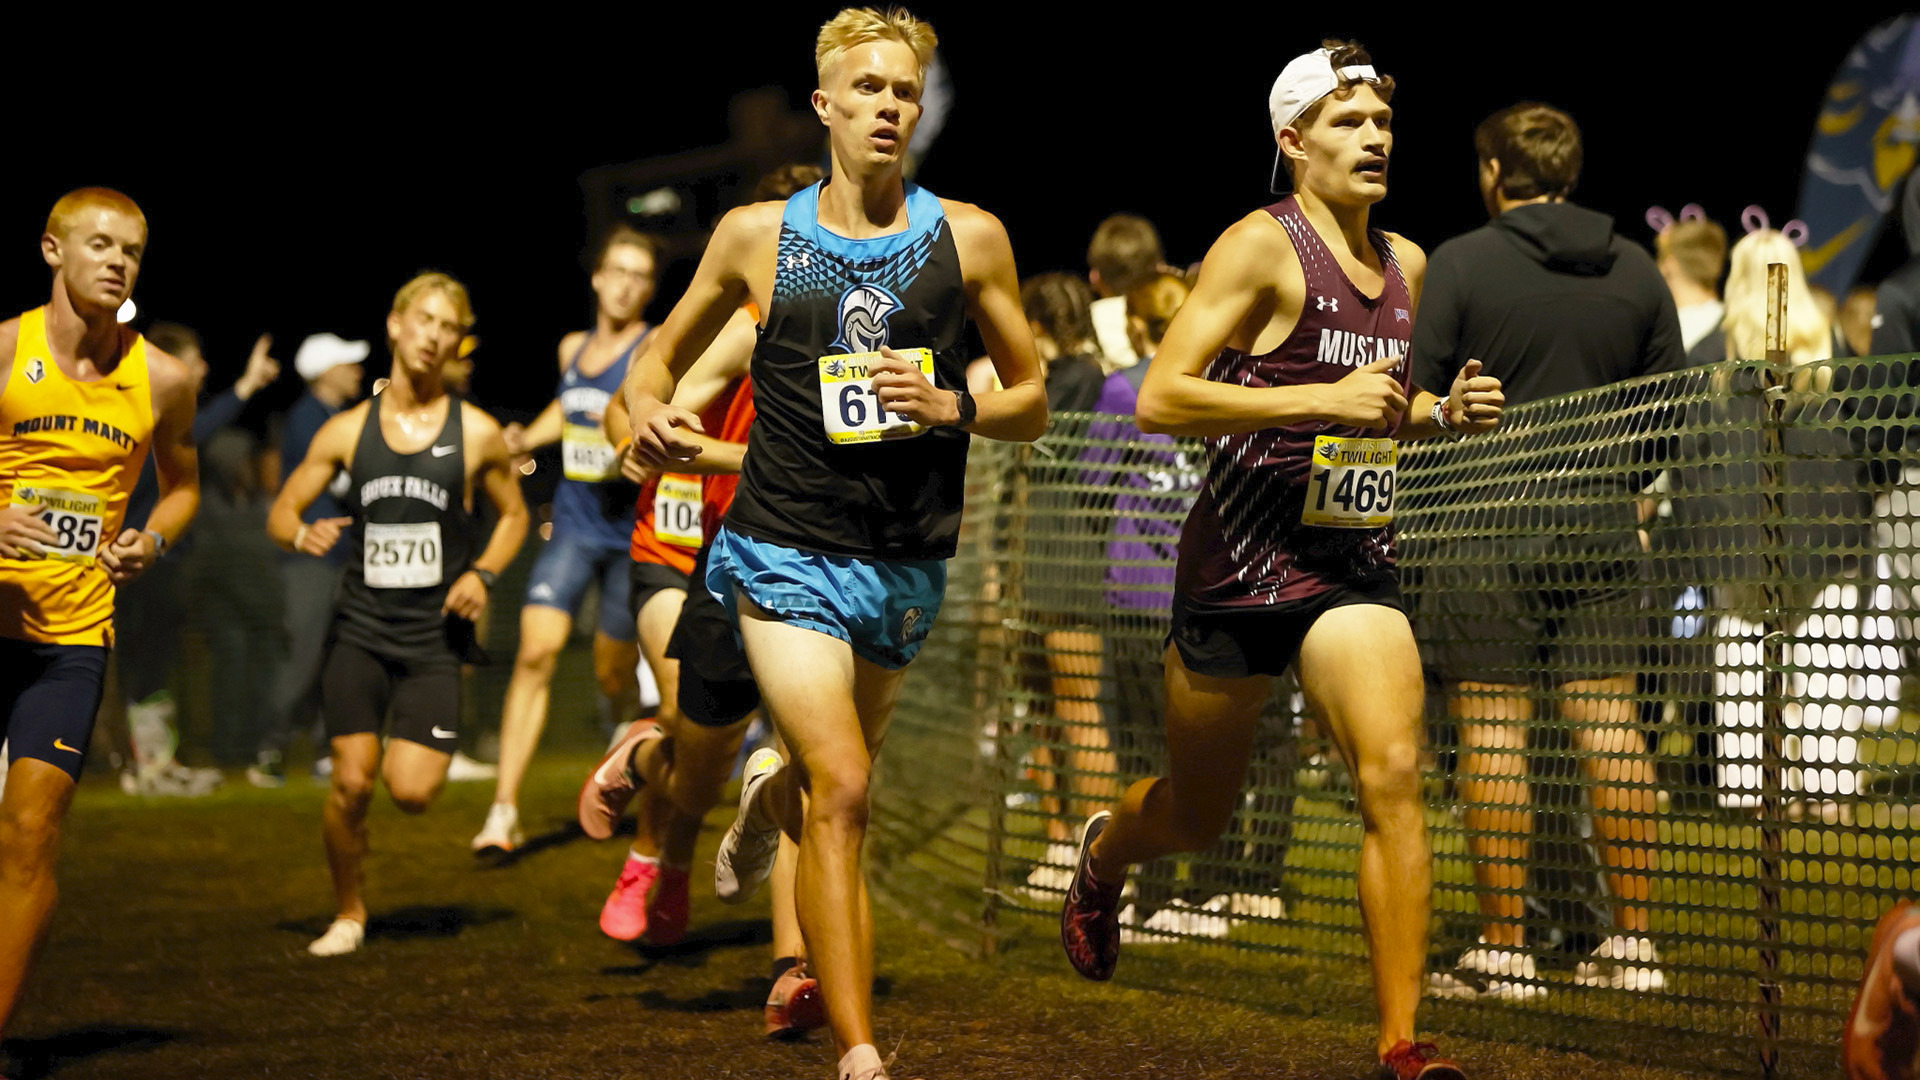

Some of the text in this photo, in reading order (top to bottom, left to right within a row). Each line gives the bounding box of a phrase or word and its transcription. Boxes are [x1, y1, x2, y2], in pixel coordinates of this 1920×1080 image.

[839, 385, 913, 428] 61
[13, 415, 77, 436] MOUNT
[1341, 450, 1392, 465] TWILIGHT
[38, 494, 98, 514] TWILIGHT
[404, 475, 449, 512] FALLS
[1314, 469, 1394, 513] 1469
[42, 512, 98, 552] 85
[365, 538, 436, 568] 2570
